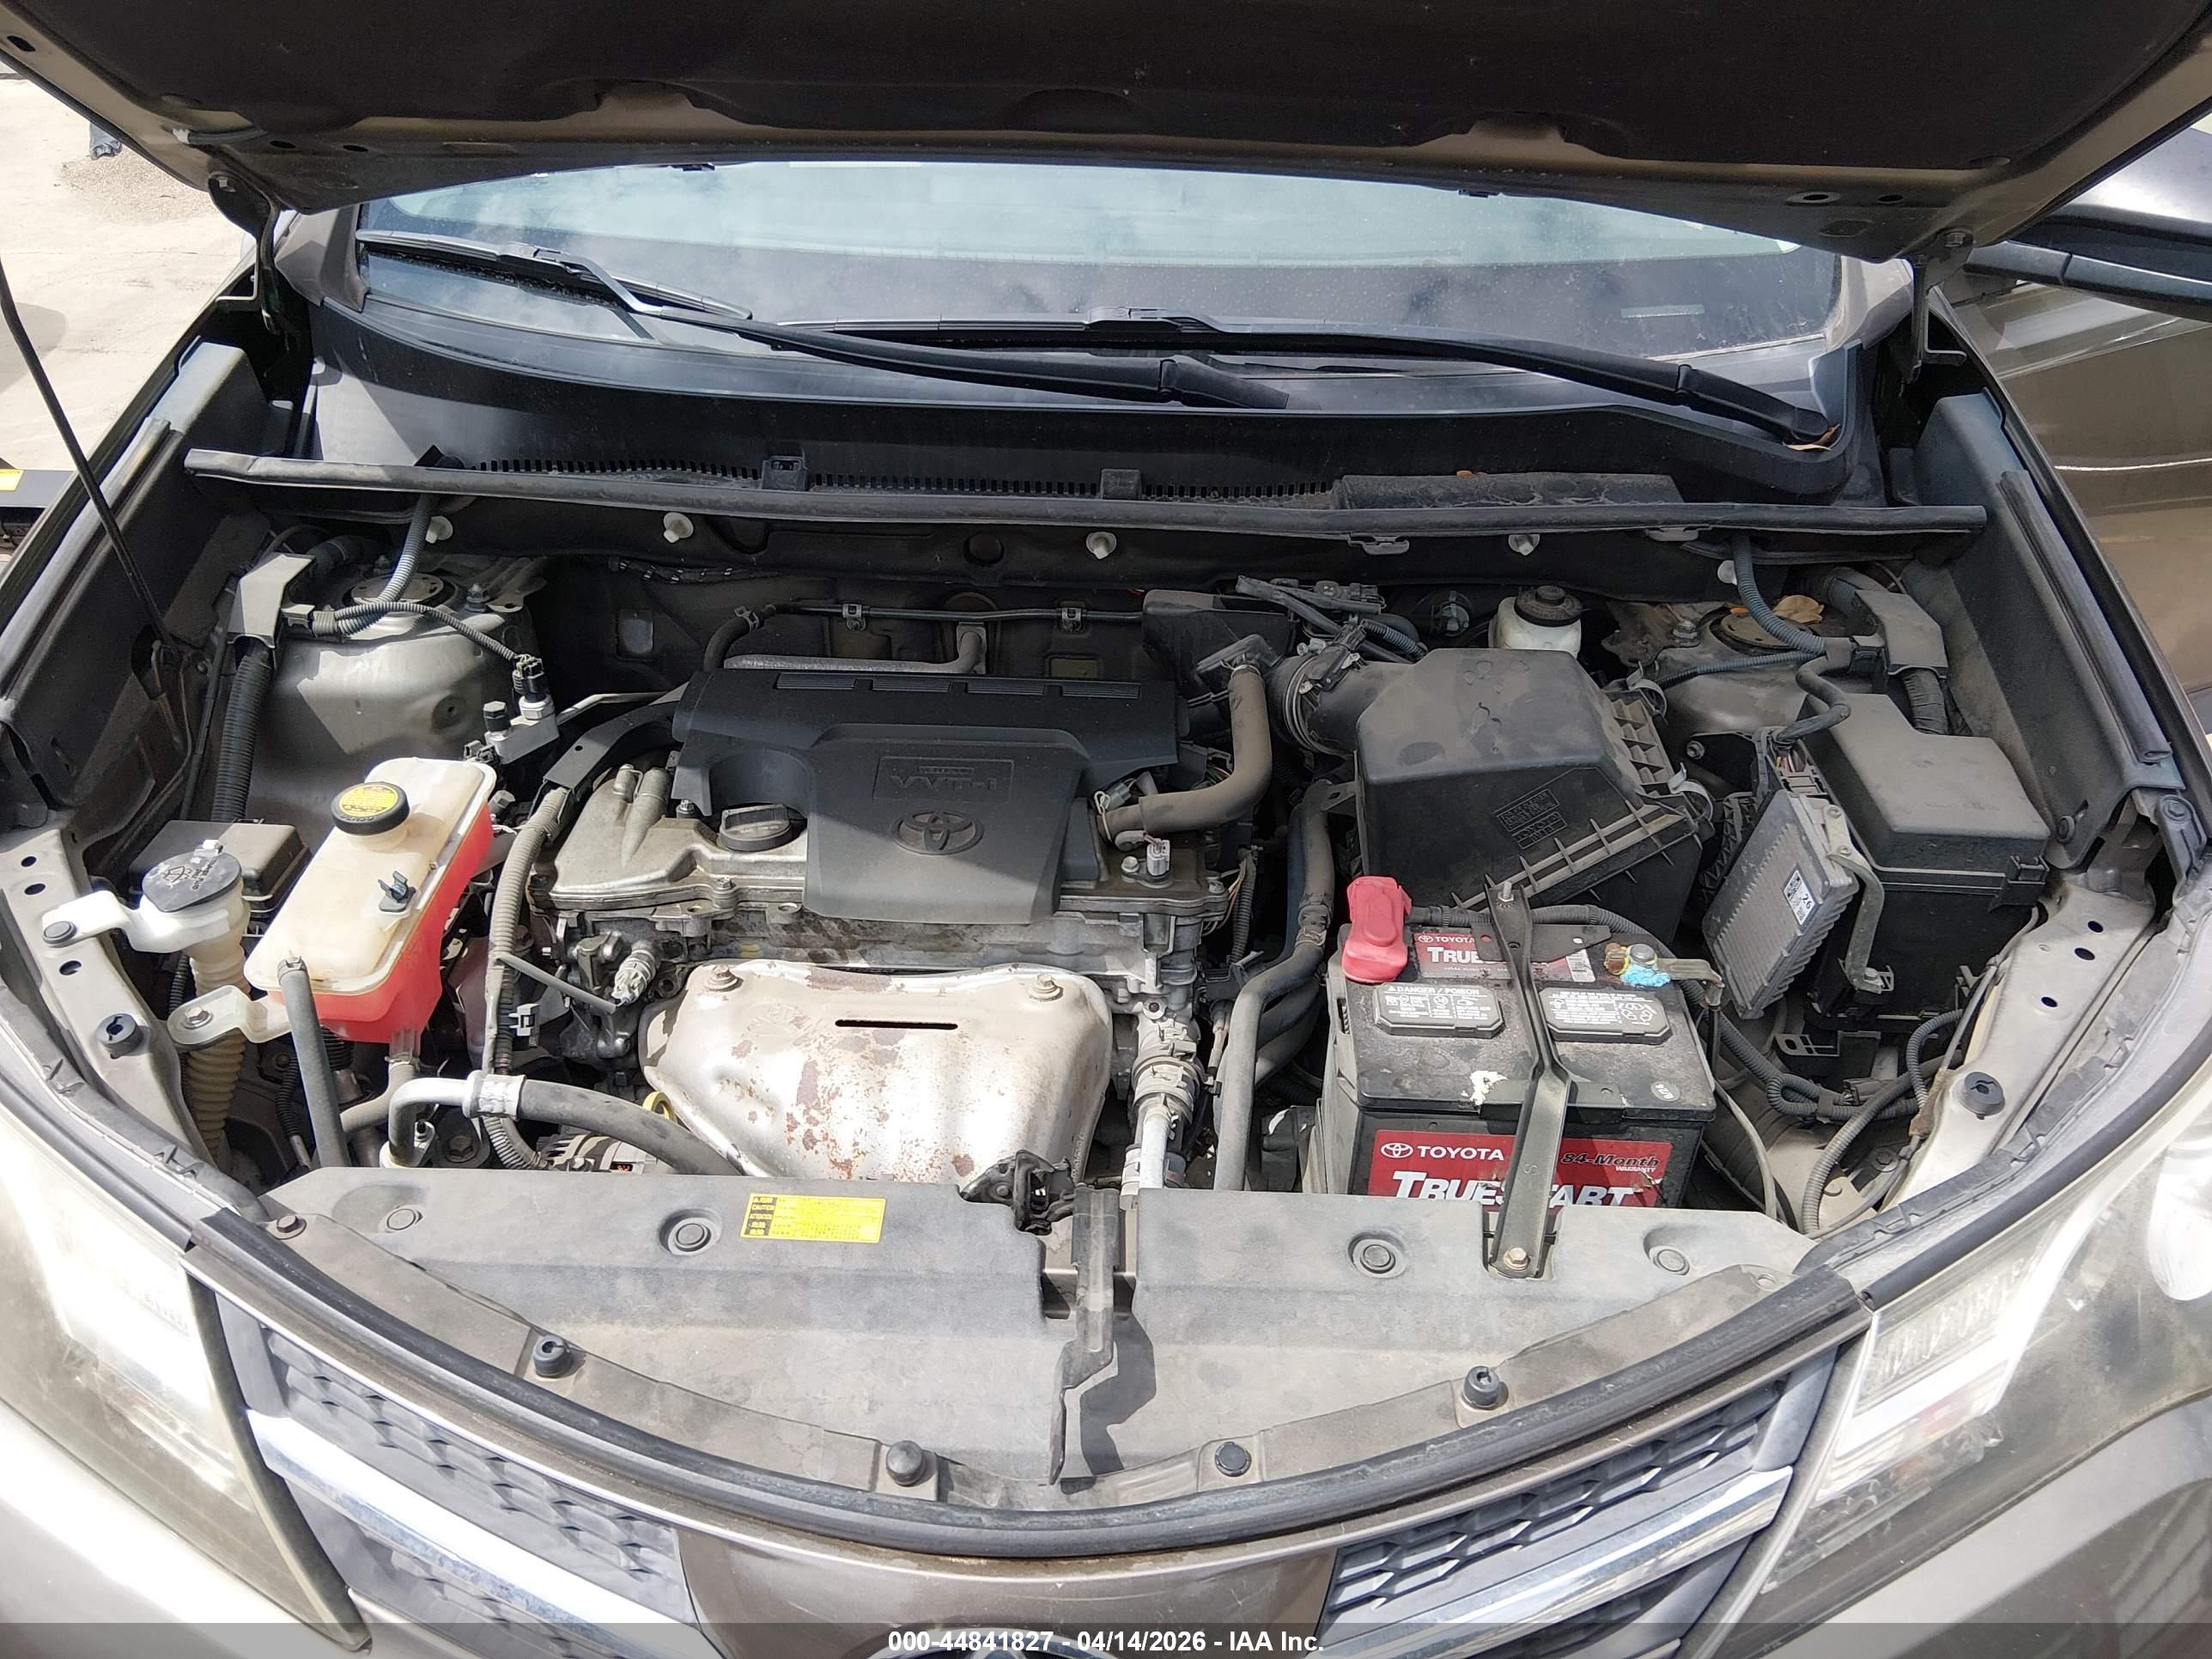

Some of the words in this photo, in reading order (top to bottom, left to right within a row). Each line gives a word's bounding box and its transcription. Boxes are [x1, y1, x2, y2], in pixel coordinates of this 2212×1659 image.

[1427, 946, 1486, 964] TRUE
[1397, 986, 1436, 994] DANGER
[1445, 988, 1480, 996] POISON
[1417, 1145, 1504, 1161] TOYOTA
[1561, 1152, 1660, 1168] 84-Month
